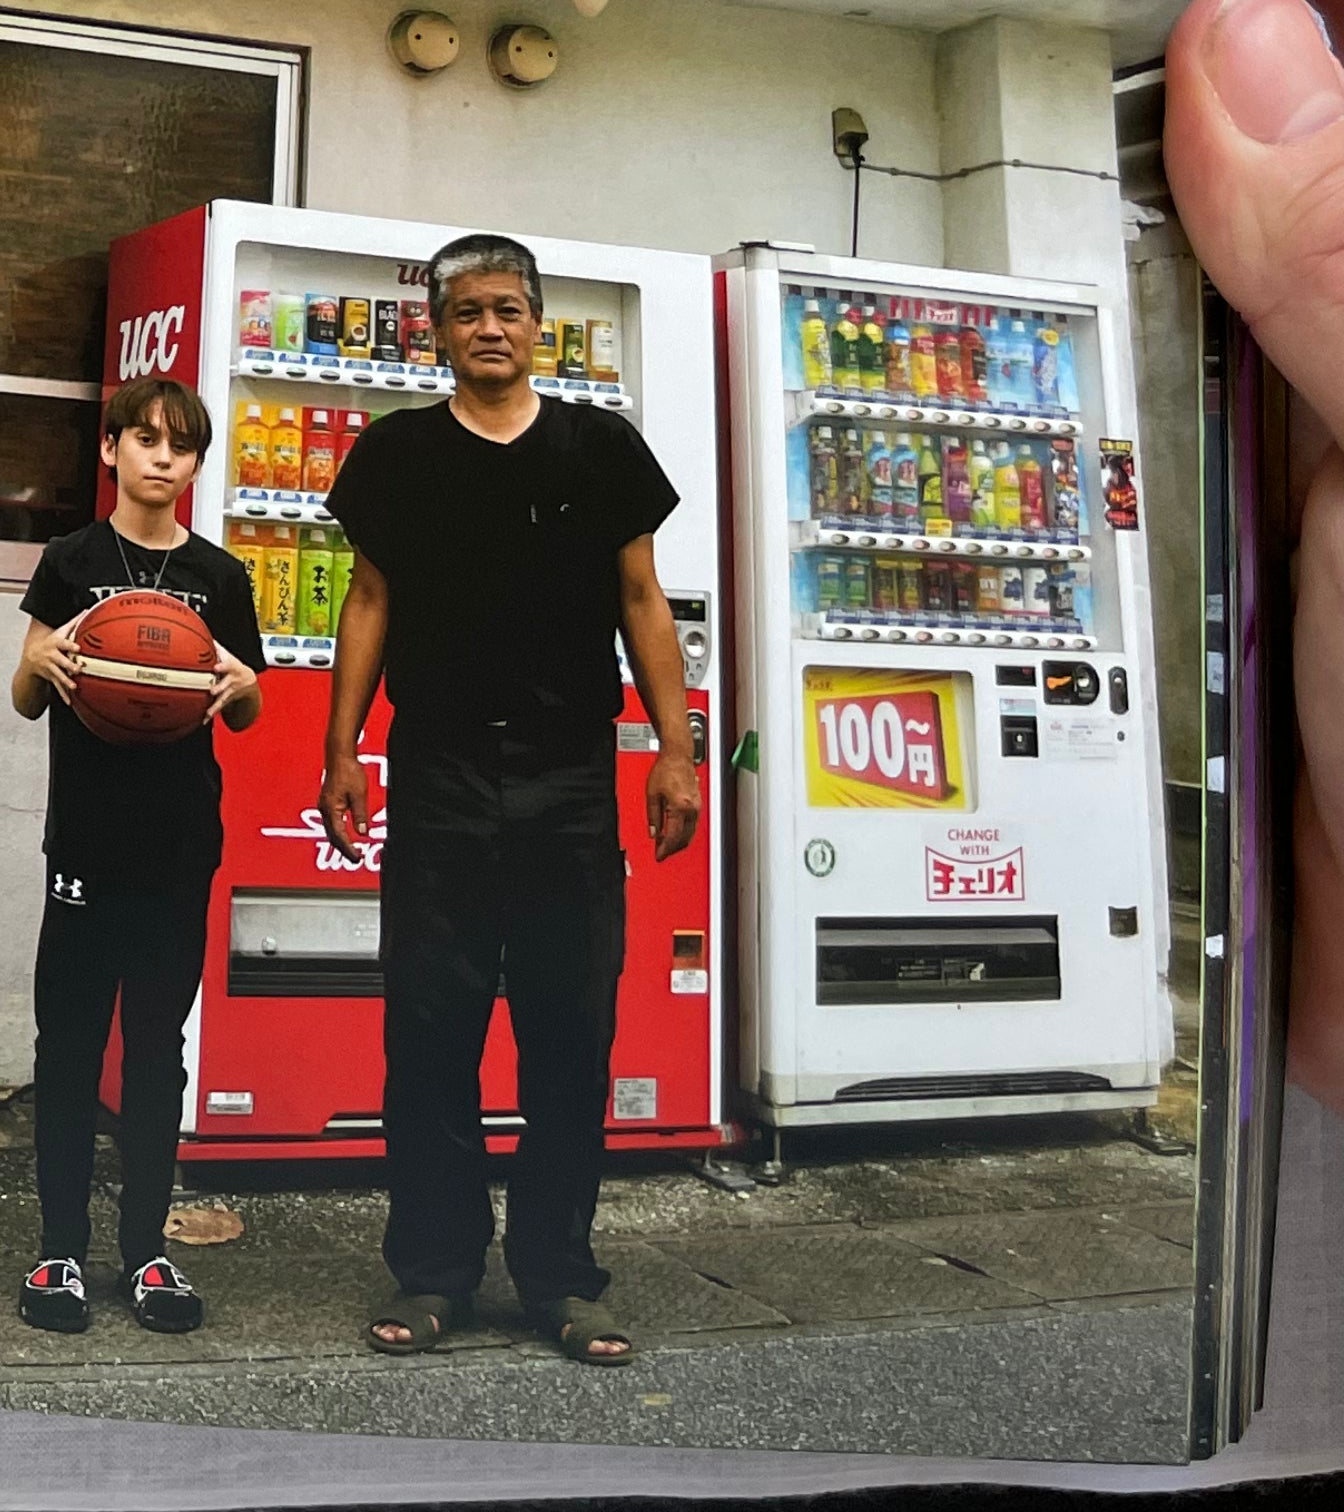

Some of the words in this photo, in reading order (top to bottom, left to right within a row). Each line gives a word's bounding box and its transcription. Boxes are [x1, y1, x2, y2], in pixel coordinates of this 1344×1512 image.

[137, 624, 172, 642] FIBA
[947, 828, 1000, 842] CHANGE
[960, 844, 990, 856] WITH
[933, 859, 1017, 895] チェリオ
